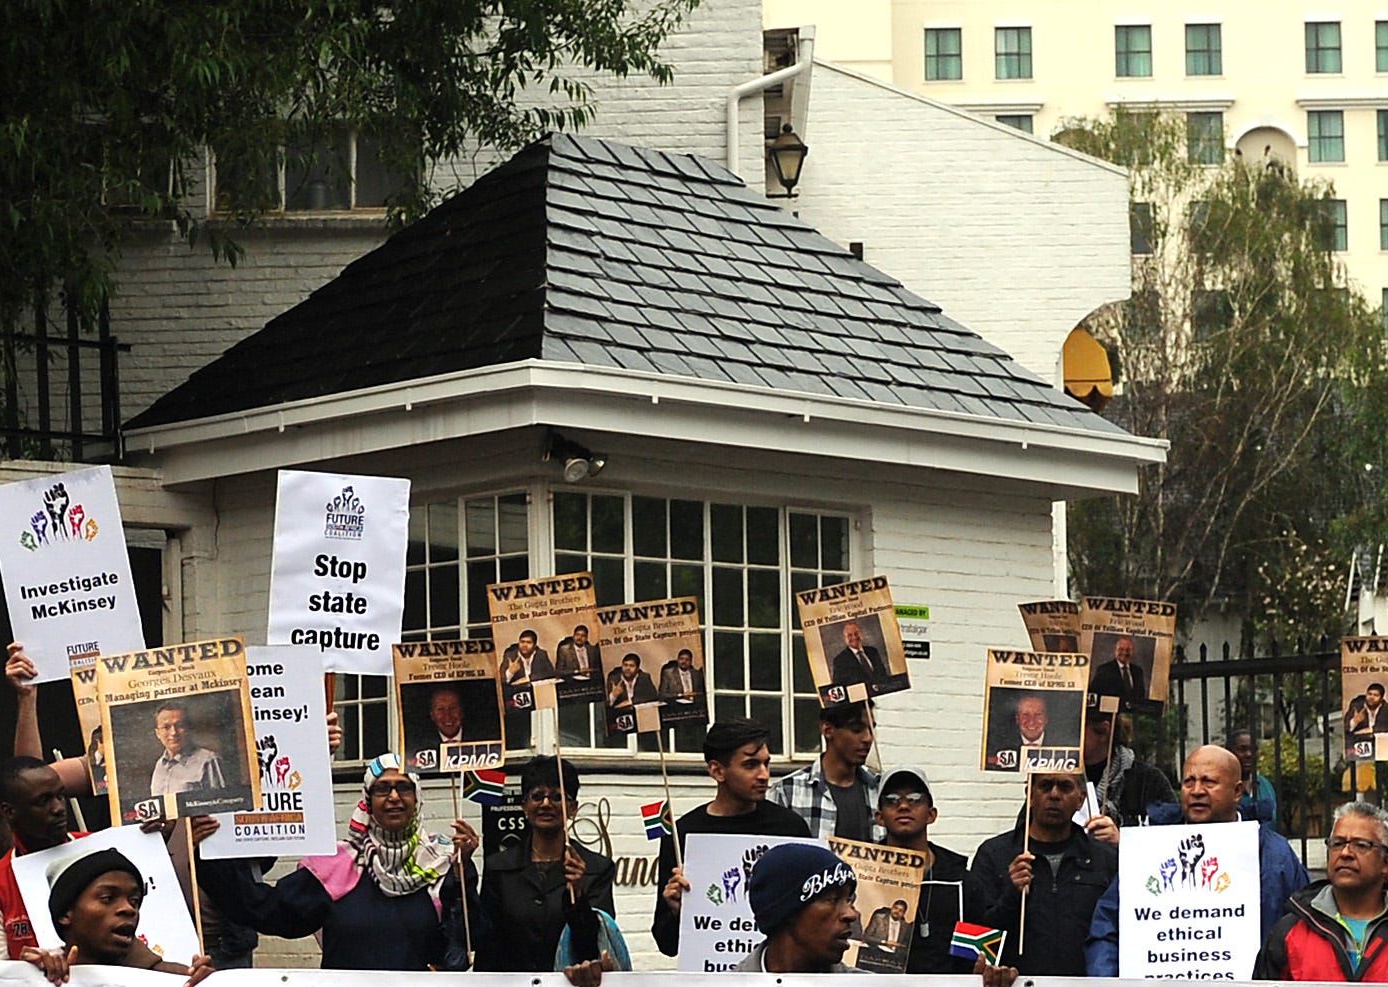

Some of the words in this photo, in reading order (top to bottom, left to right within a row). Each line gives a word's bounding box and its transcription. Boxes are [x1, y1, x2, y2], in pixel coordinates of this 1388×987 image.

[326, 513, 364, 526] FUTURE
[314, 554, 367, 584] Stop
[20, 572, 119, 600] Investigate
[491, 576, 593, 602] WANTED
[799, 577, 887, 606] WANTED
[31, 595, 116, 620] McKinsey
[308, 591, 367, 615] state
[1085, 598, 1175, 617] WANTED
[597, 601, 697, 626] WANTED
[67, 641, 100, 655] FUTURE
[291, 627, 380, 653] capture
[397, 640, 495, 658] WANTED
[101, 639, 243, 675] WANTED
[993, 650, 1089, 668] WANTED
[247, 664, 285, 676] ome
[128, 676, 171, 690] Georges
[173, 670, 217, 684] Desvaux
[105, 688, 151, 704] Managing
[154, 686, 187, 699] partner
[189, 682, 199, 692] at
[251, 686, 285, 698] ean
[255, 705, 309, 722] insey!
[445, 752, 499, 770] KPMG
[1024, 757, 1077, 772] KPMG
[235, 824, 305, 836] COALITION
[497, 817, 525, 830] CSS
[828, 840, 925, 868] WANTED
[1134, 907, 1162, 921] We
[1169, 904, 1245, 919] demand
[693, 916, 722, 930] We
[1157, 926, 1222, 942] ethical
[1147, 948, 1231, 964] business
